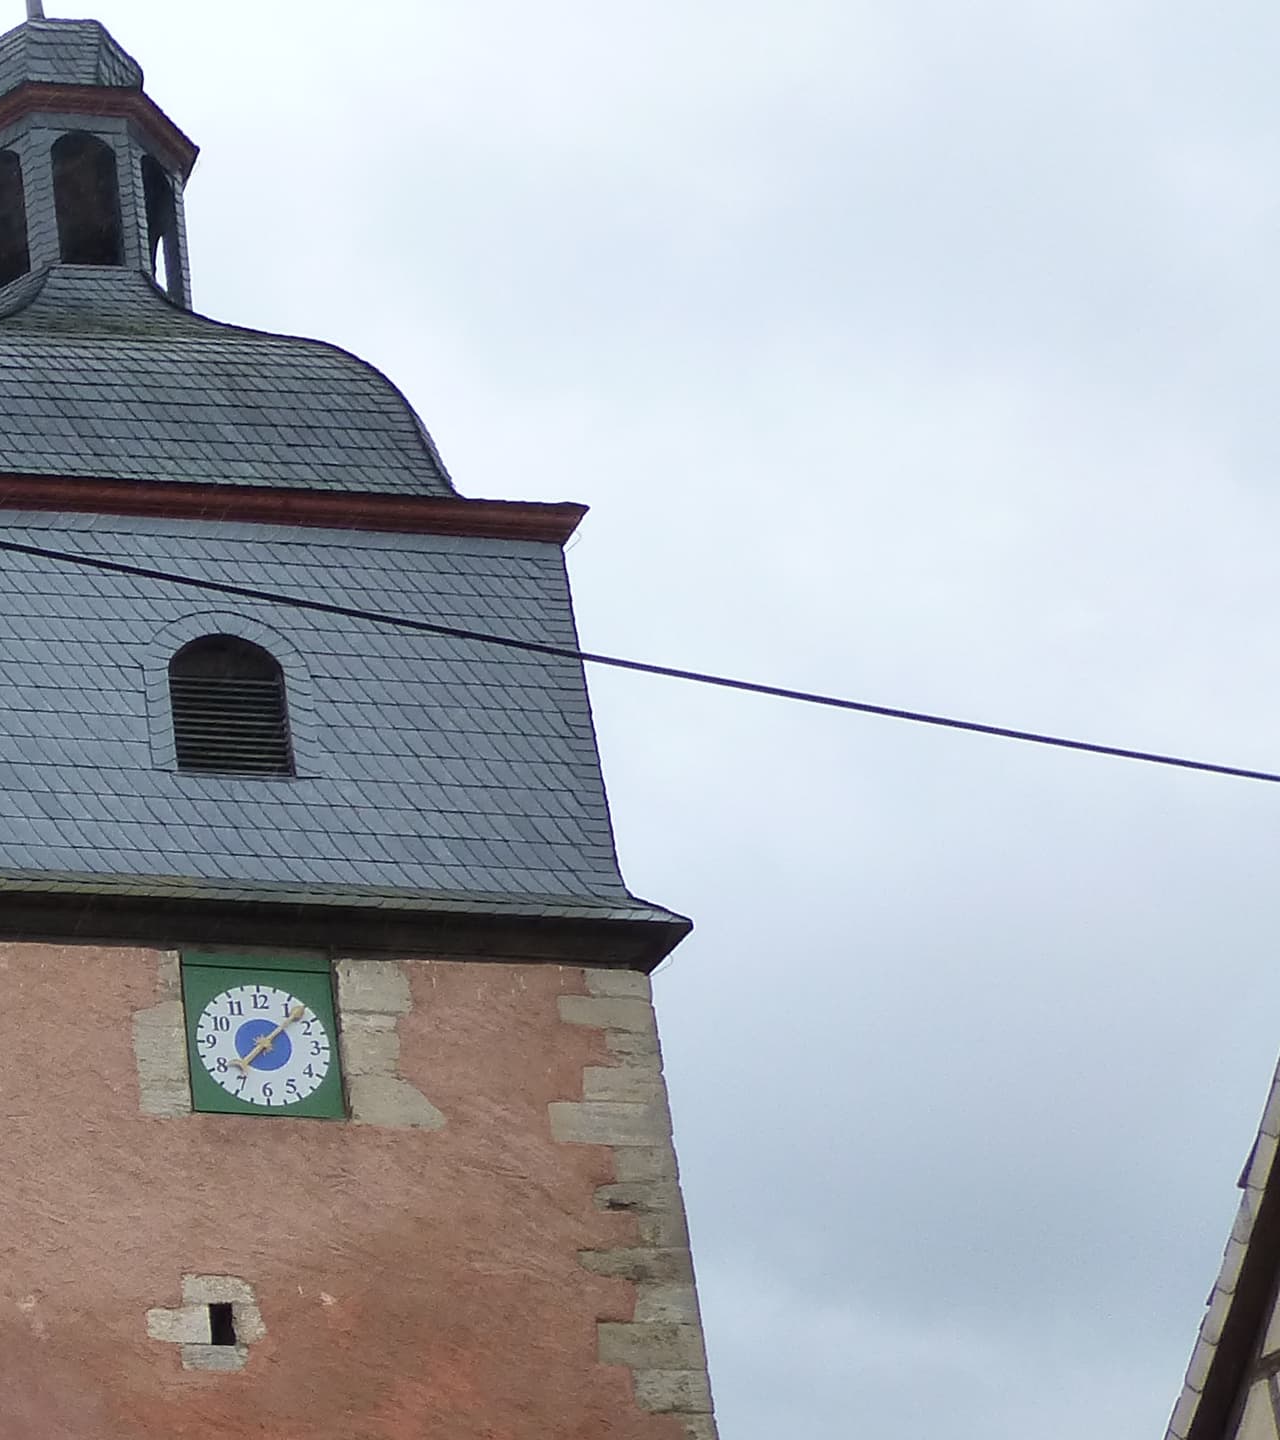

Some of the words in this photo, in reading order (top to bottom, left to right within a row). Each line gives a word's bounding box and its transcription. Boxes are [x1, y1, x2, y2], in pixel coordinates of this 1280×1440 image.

[227, 1001, 243, 1016] 11
[251, 994, 269, 1009] 12
[281, 1003, 289, 1018] 1
[213, 1016, 230, 1031] 10
[301, 1020, 312, 1035] 2
[206, 1034, 217, 1049] 9
[310, 1040, 320, 1055] 3
[217, 1057, 228, 1072] 8
[303, 1063, 313, 1078] 4
[237, 1075, 247, 1091] 7
[262, 1082, 273, 1097] 6
[285, 1079, 297, 1093] 5
